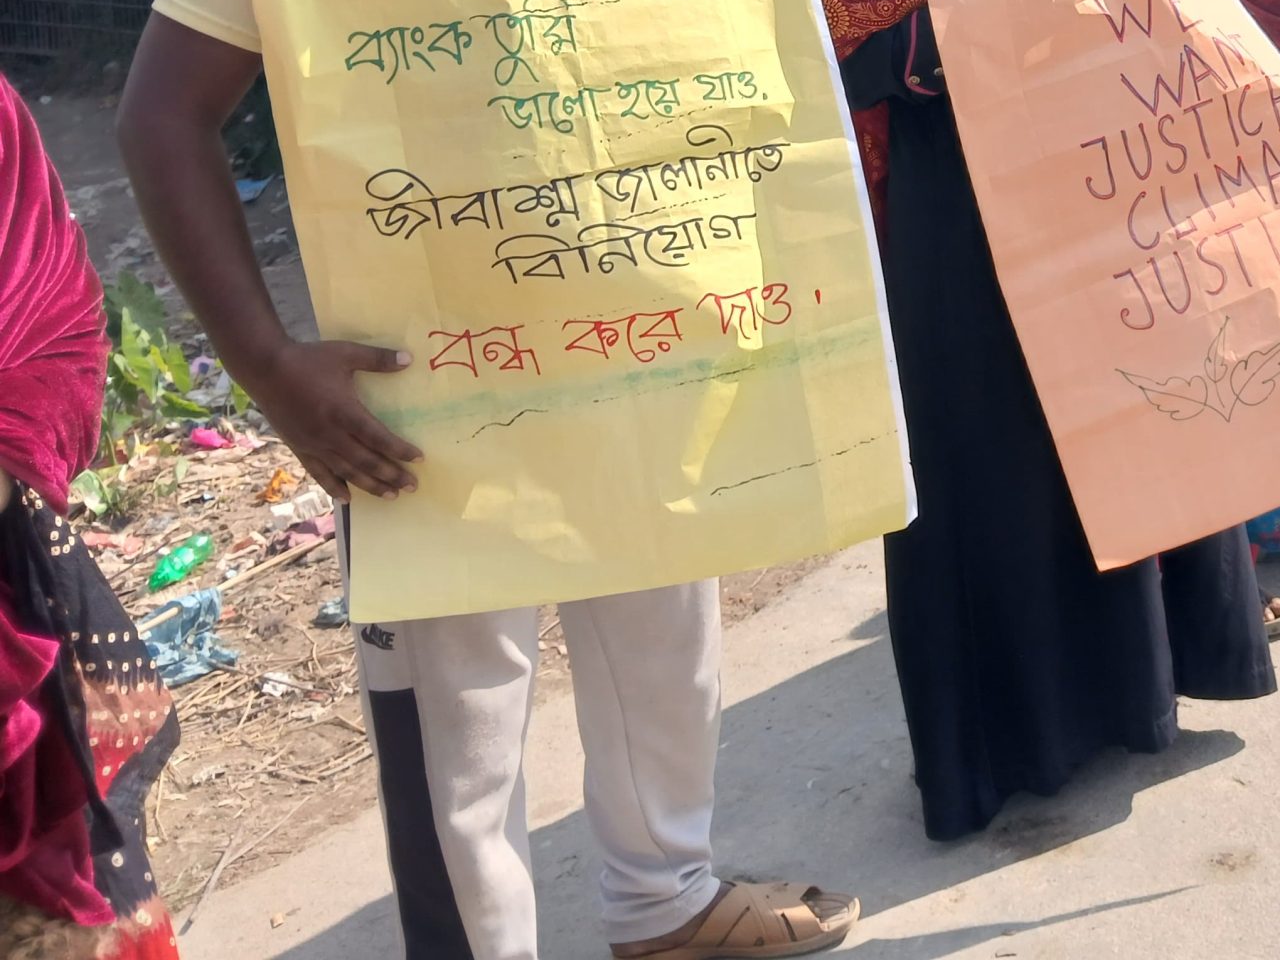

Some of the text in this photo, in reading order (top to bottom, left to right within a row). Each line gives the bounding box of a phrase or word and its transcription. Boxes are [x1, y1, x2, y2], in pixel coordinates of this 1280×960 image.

[345, 19, 474, 85] ব্যাংক
[488, 88, 612, 134] ভালো
[617, 79, 680, 120] হয়ে
[366, 168, 582, 240] জীবাশ্ম
[492, 214, 757, 284] বিনিয়োগ
[428, 324, 541, 378] বন্ধ
[562, 308, 685, 363] করে
